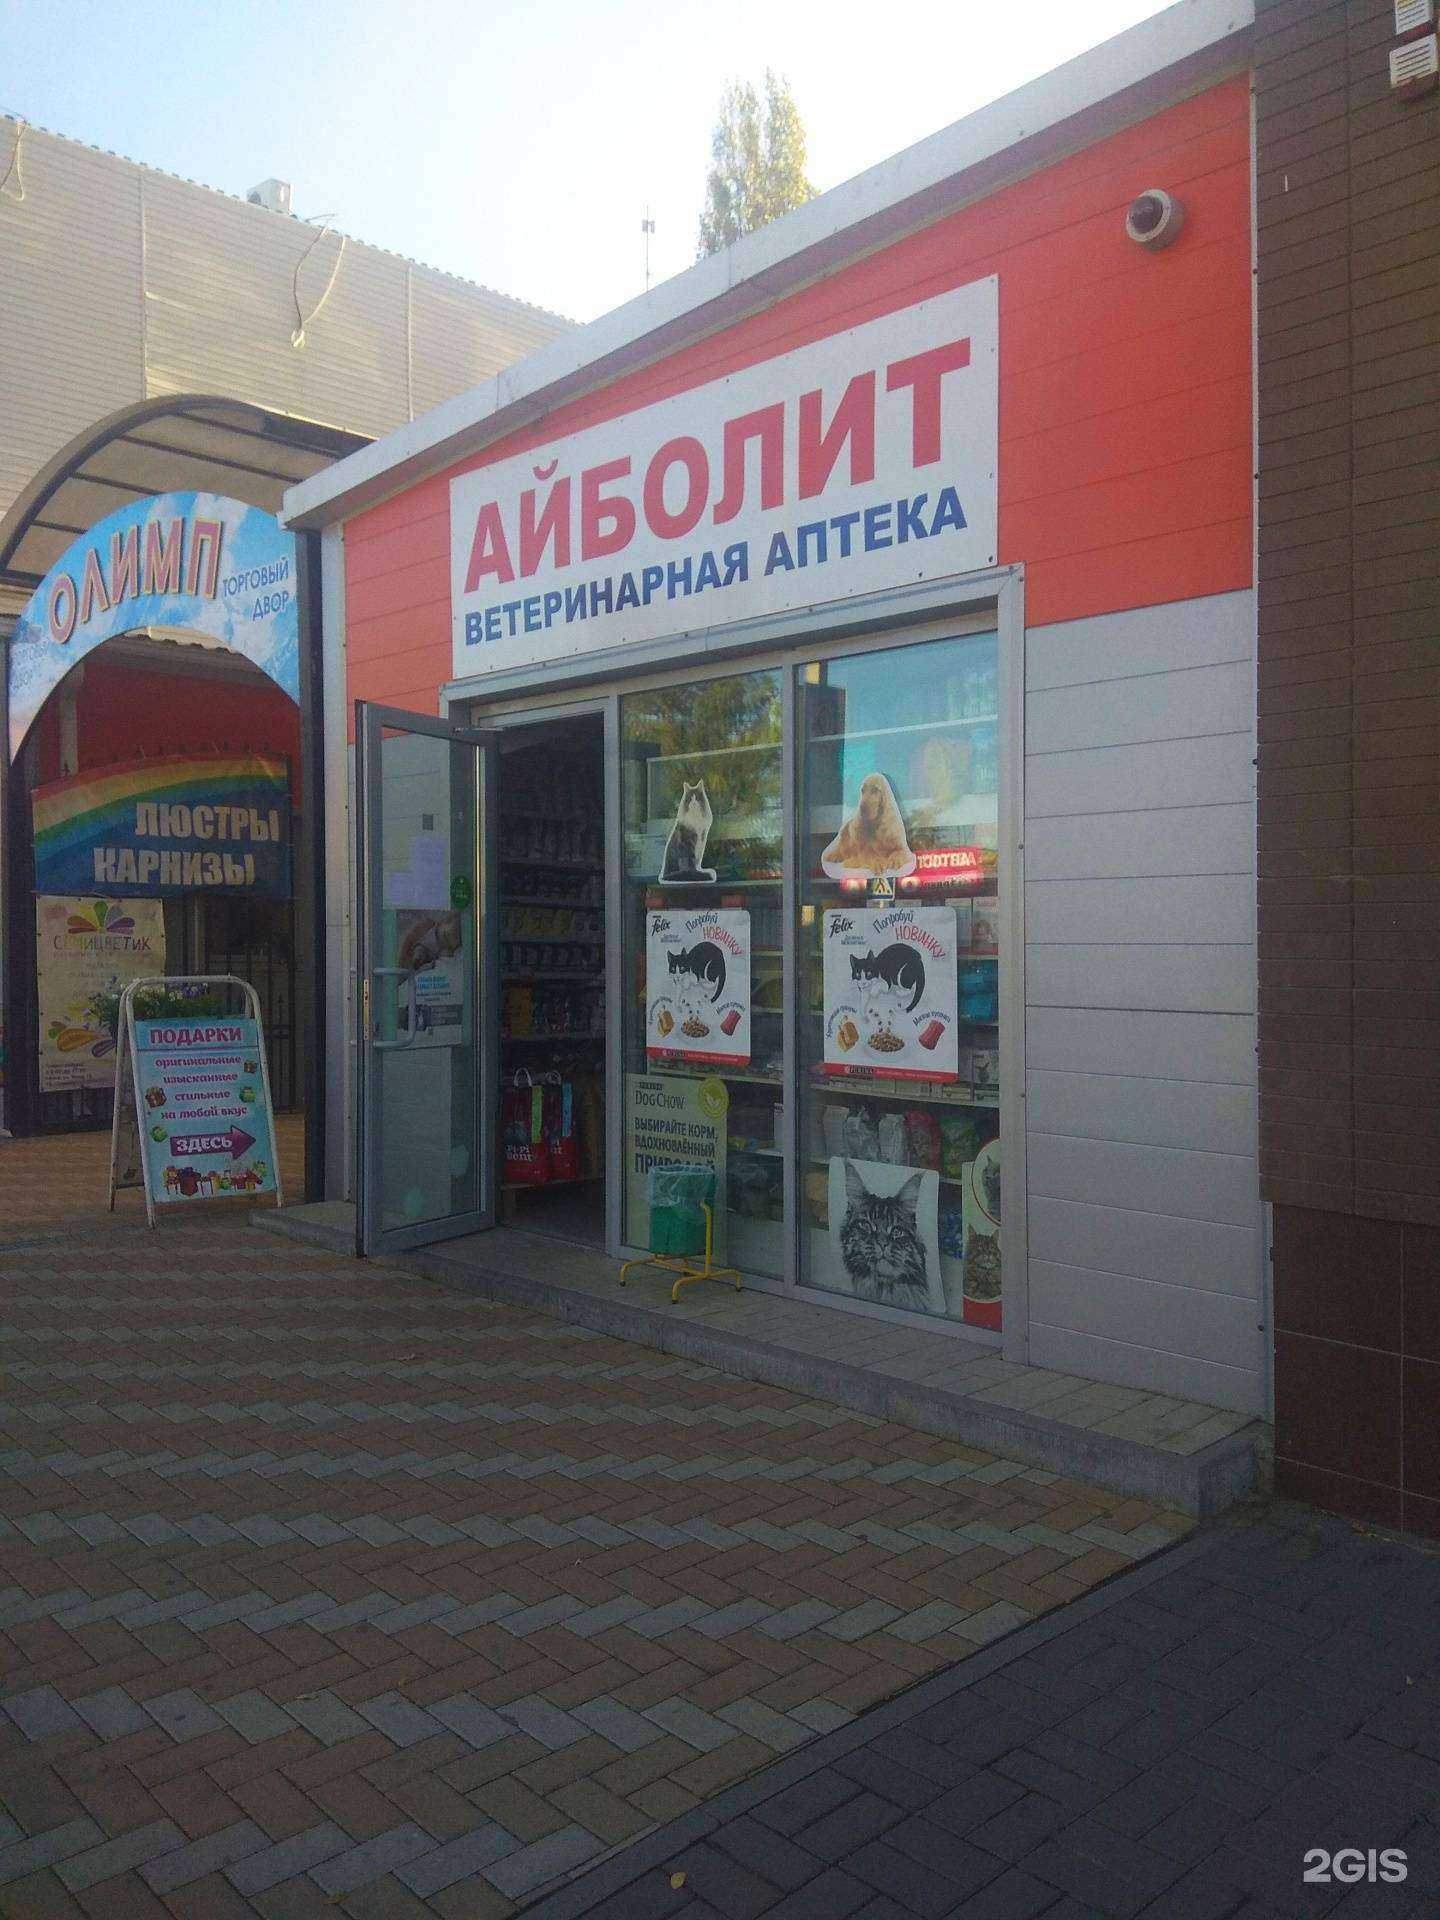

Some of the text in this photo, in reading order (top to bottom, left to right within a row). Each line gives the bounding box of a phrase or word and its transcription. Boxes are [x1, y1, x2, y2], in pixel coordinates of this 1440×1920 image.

[464, 337, 971, 594] АЙБОЛИТ
[50, 516, 222, 644] ОЛИМП
[222, 556, 289, 597] ТОРГОВЫЙ
[465, 486, 968, 646] ВЕТЕРИНАРНАЯ АПТЕКА
[252, 591, 289, 621] ДВОР
[135, 802, 280, 842] ЛЮСТРЫ
[93, 847, 256, 886] КАРНИЗЫ
[895, 923, 946, 958] НОВИНКУ
[150, 1028, 242, 1046] ПОДАРКИ
[155, 1056, 241, 1068] оригинальные
[163, 1074, 238, 1084] изысканные
[174, 1091, 231, 1102] стильные
[161, 1106, 247, 1120] на любой вкус
[635, 1117, 687, 1136] ВЫБИРАЙТЕ
[176, 1136, 233, 1153] ЗДЕСЬ
